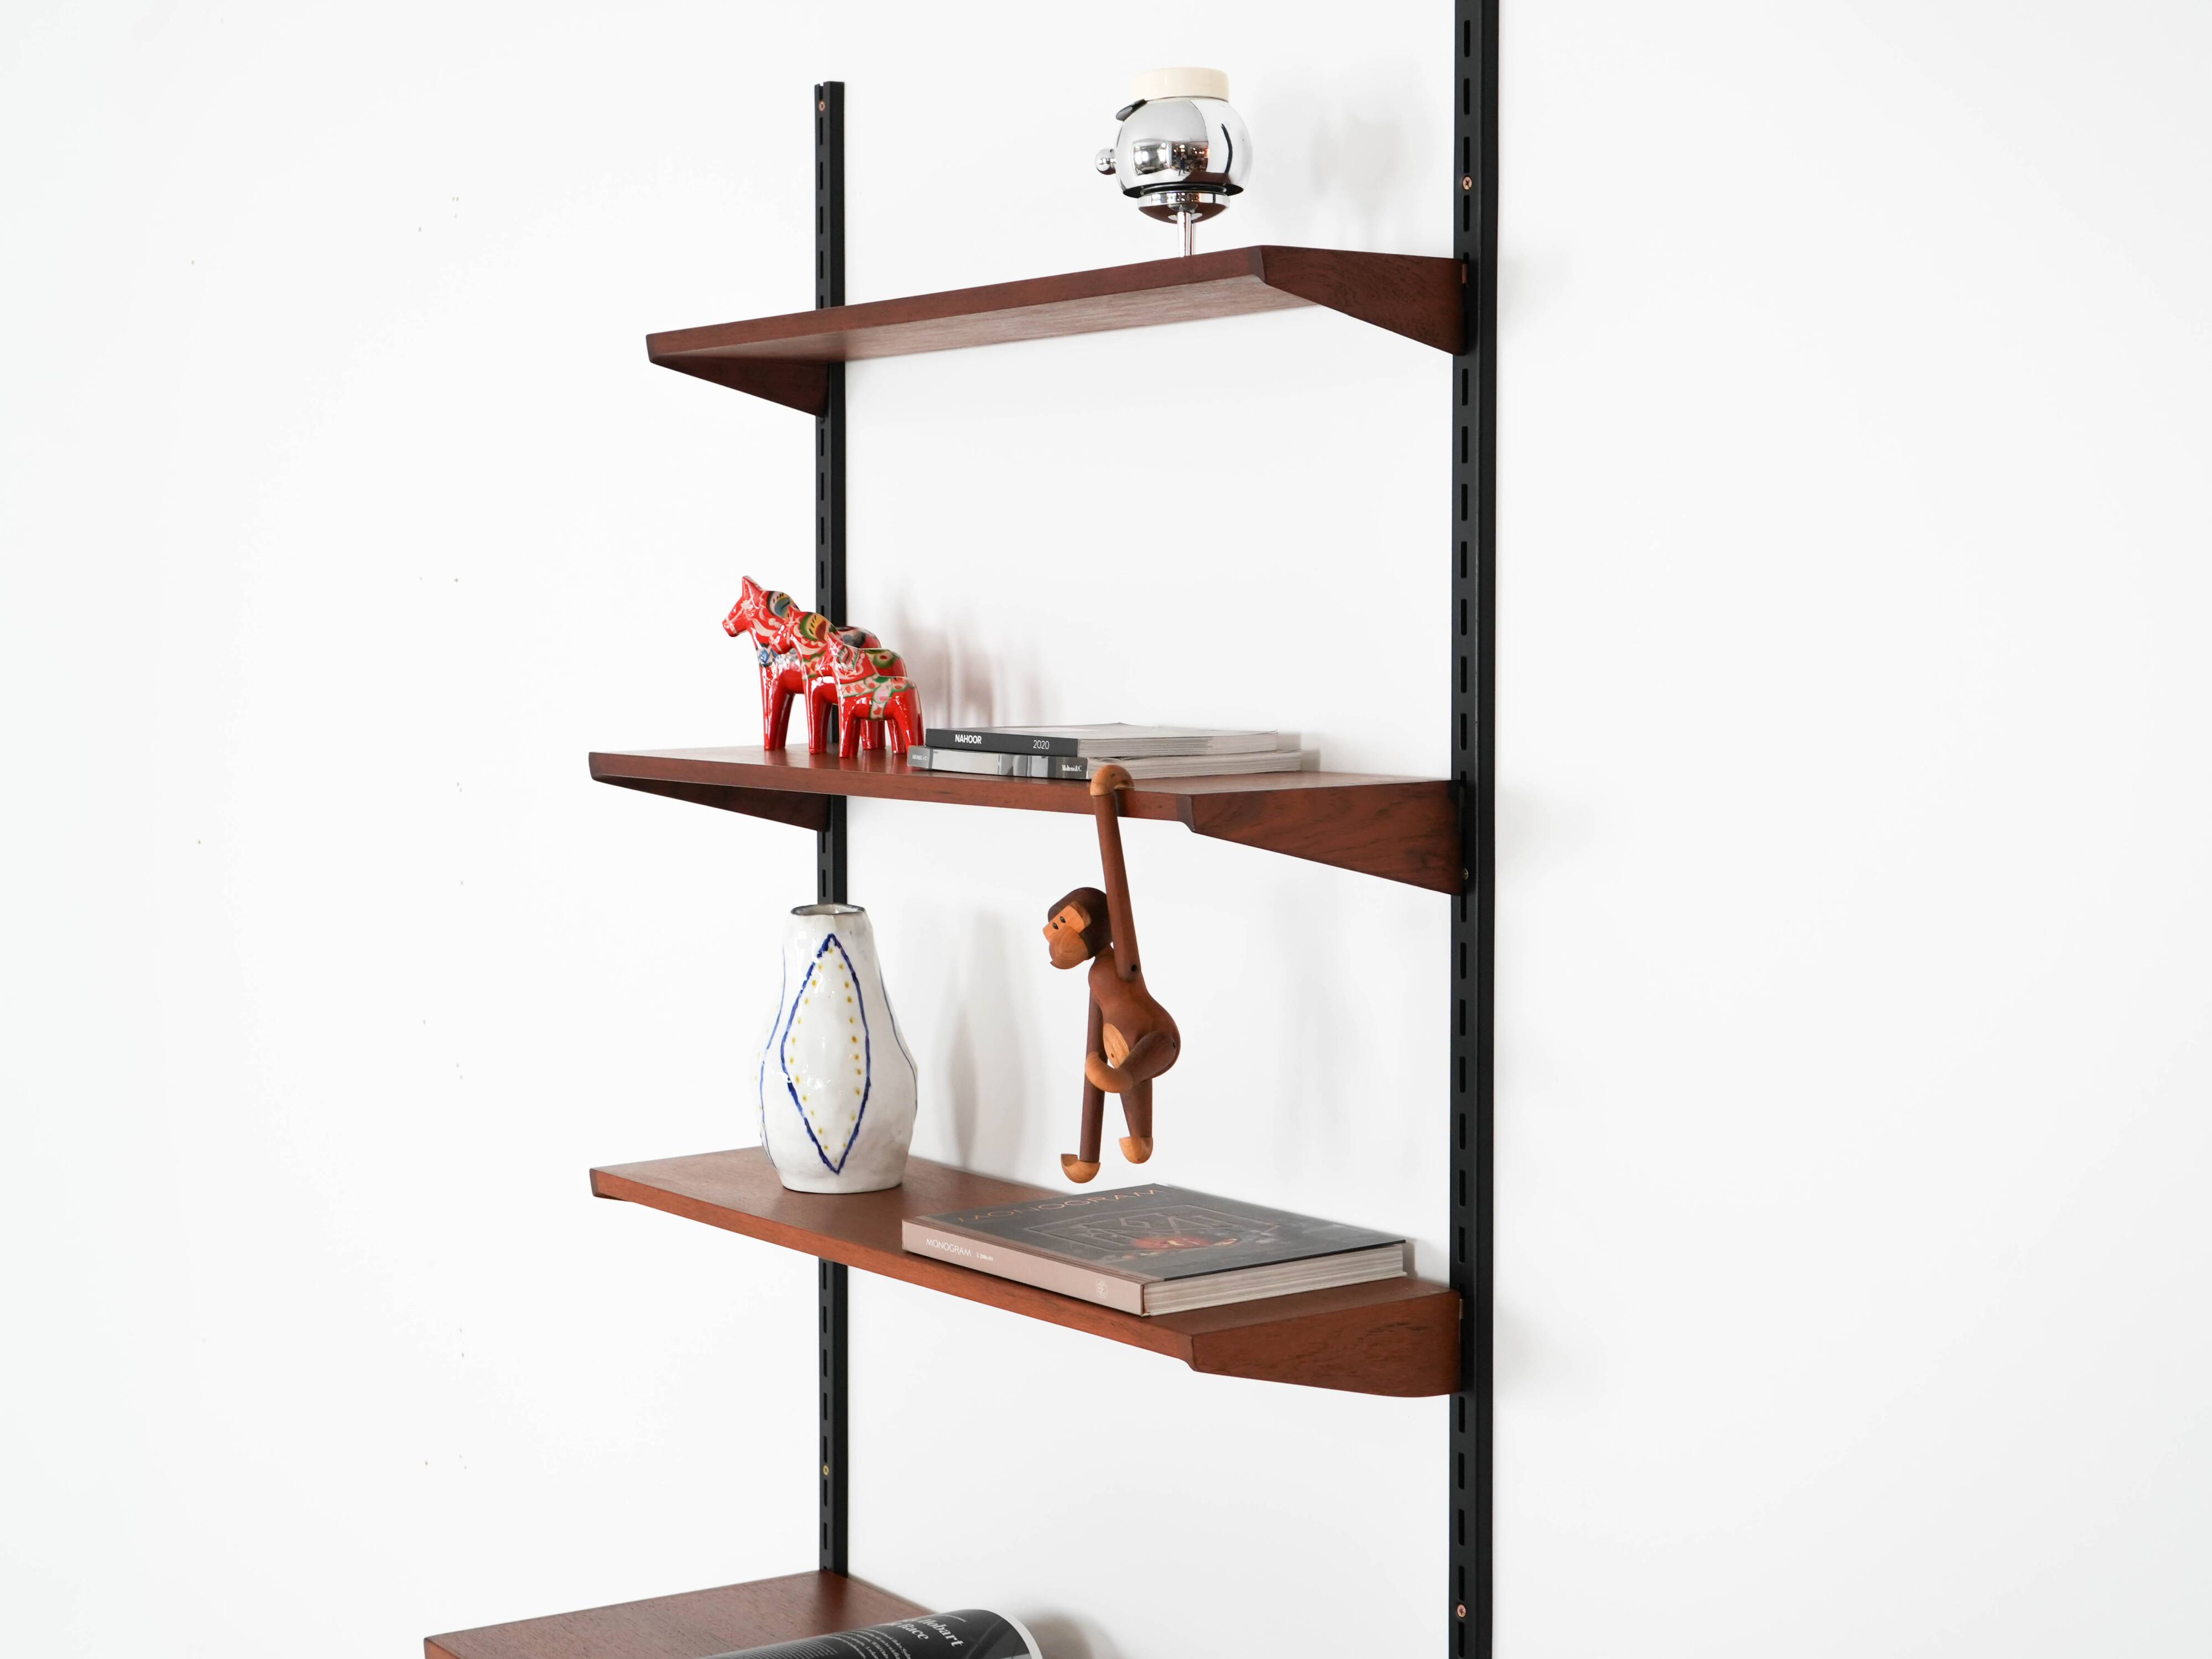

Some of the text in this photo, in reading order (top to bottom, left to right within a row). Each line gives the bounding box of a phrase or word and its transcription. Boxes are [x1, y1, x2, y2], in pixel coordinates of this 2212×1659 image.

[954, 734, 1050, 750] NAHOOR 2020
[957, 1188, 1166, 1223] MONOGRAM
[926, 1238, 972, 1257] MONOGRAM
[897, 1623, 930, 1640] Race
[917, 1618, 964, 1647] Hobart
